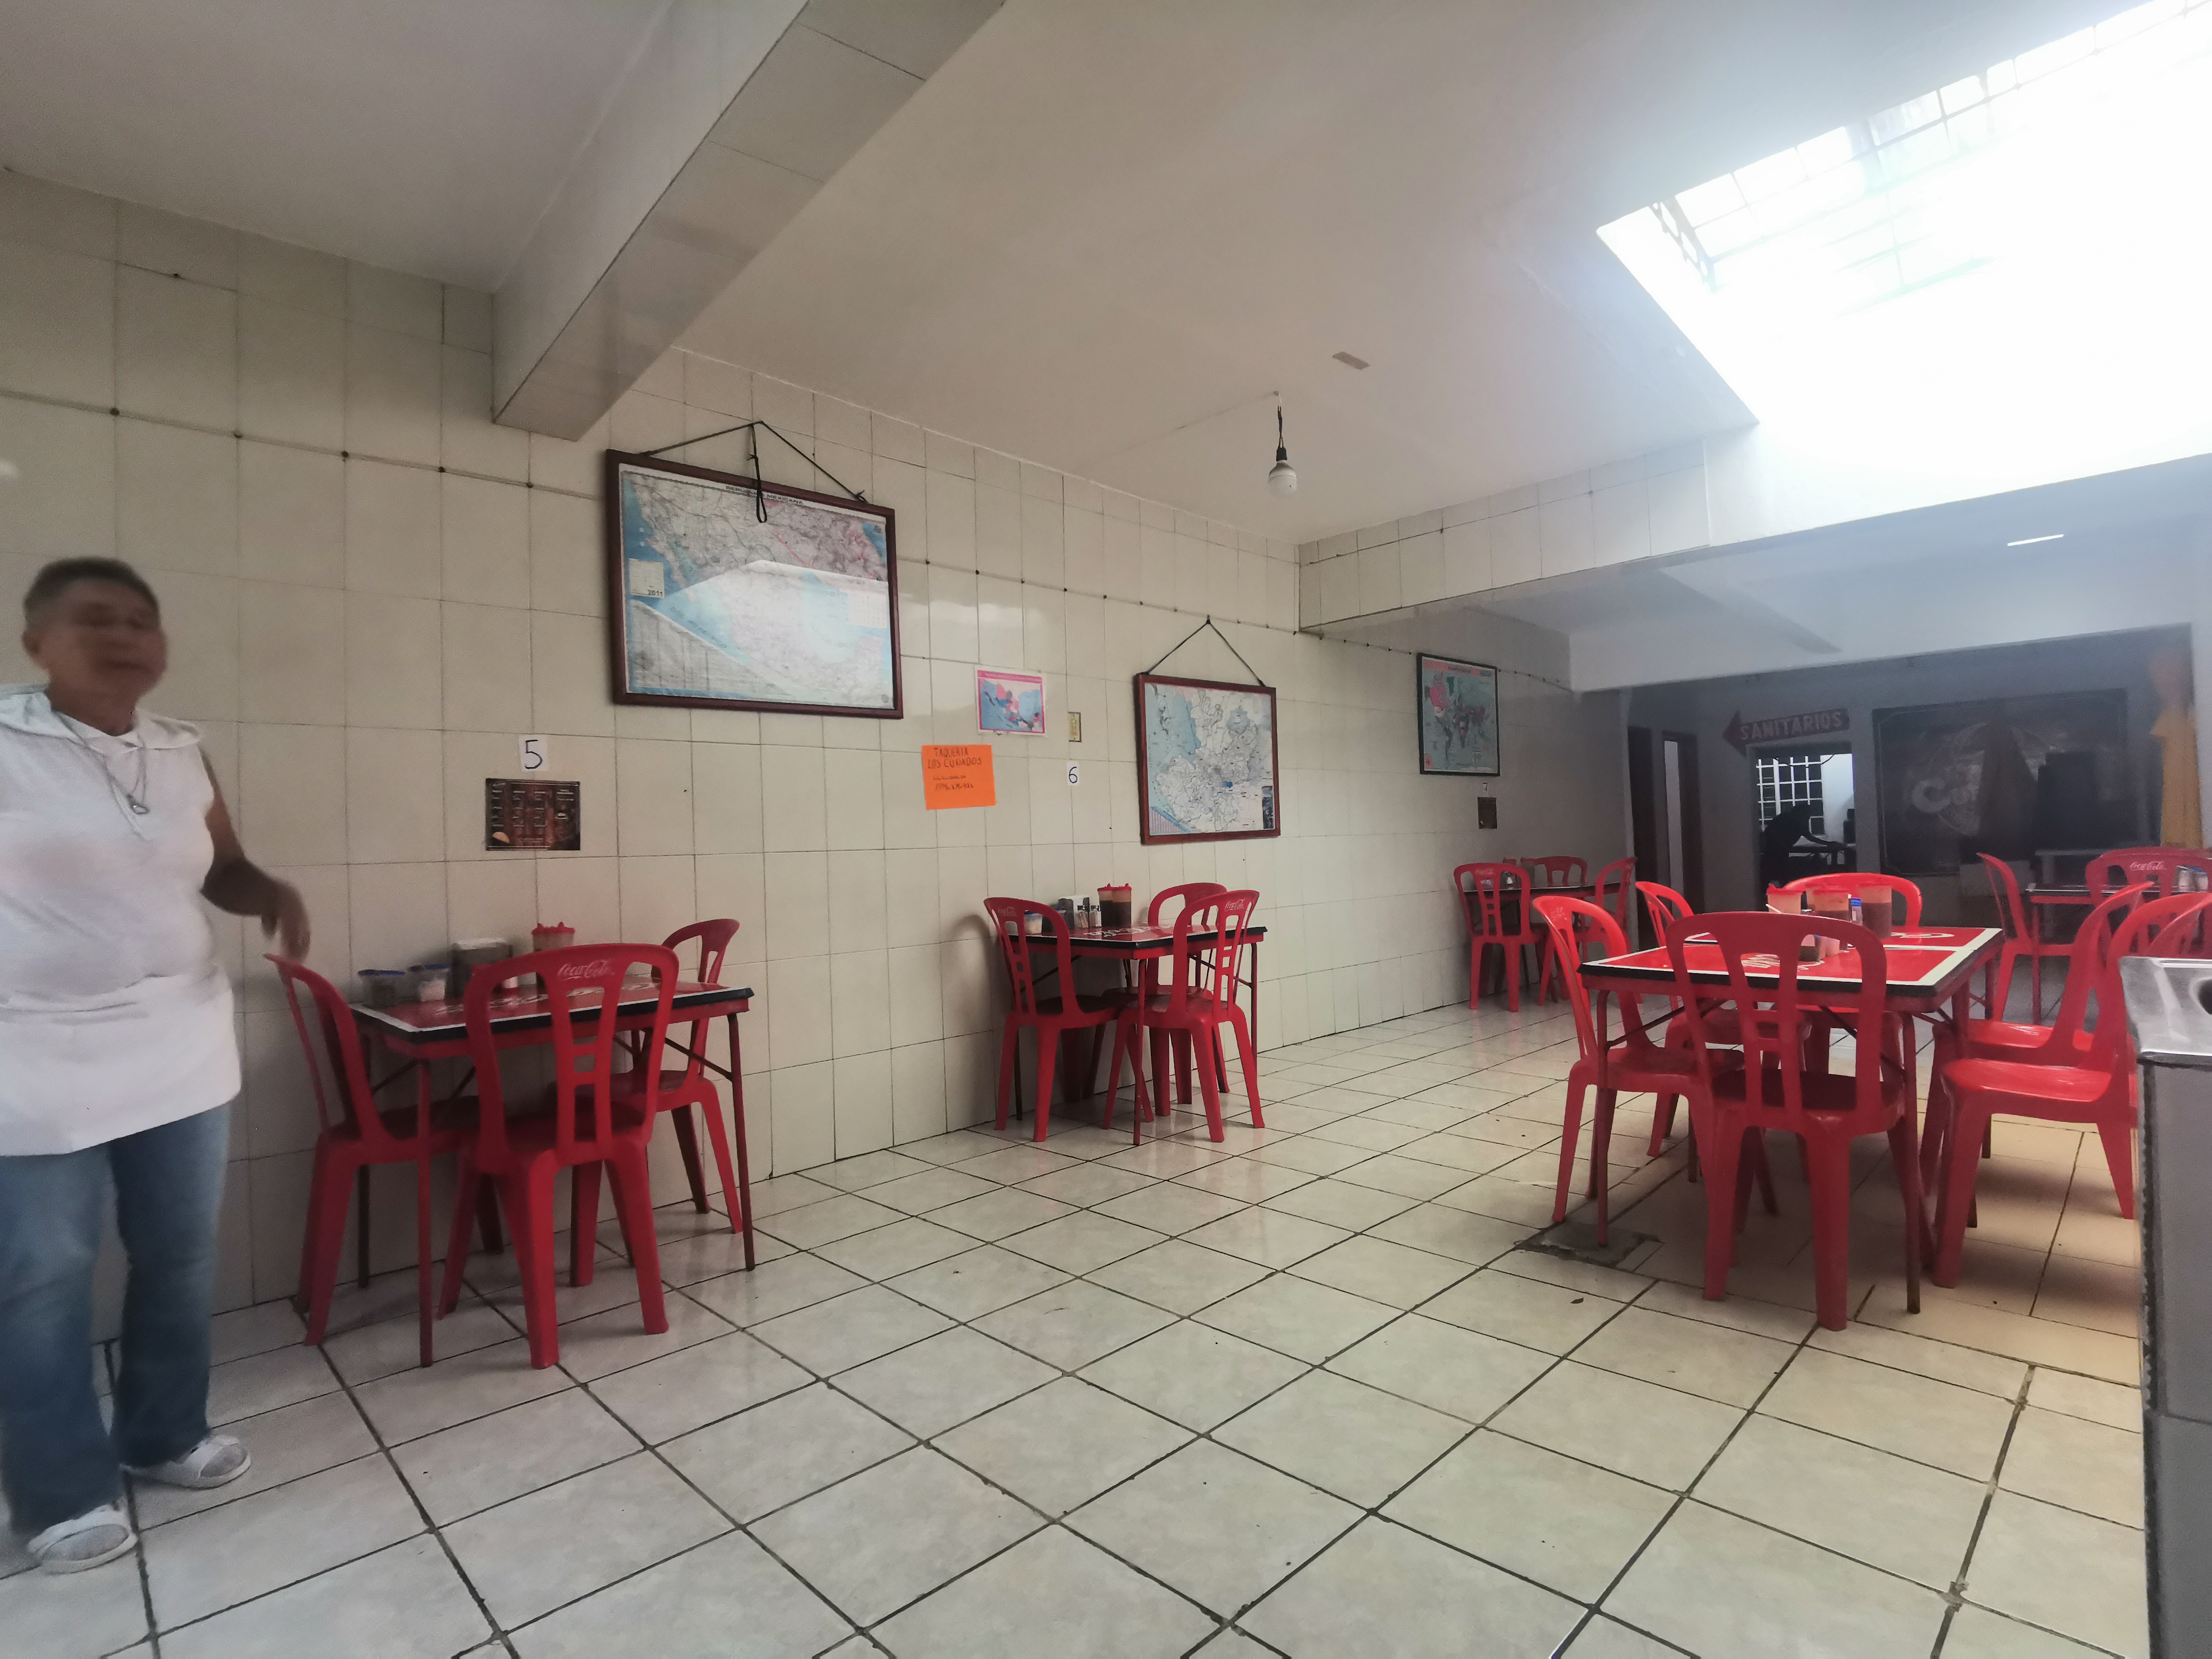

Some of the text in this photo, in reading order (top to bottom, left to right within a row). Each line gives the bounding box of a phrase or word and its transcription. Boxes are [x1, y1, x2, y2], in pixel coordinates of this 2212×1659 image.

[1740, 710, 1842, 741] SANITARIOS
[525, 739, 543, 769] 5
[928, 759, 941, 769] LOS
[1069, 766, 1078, 783] 6
